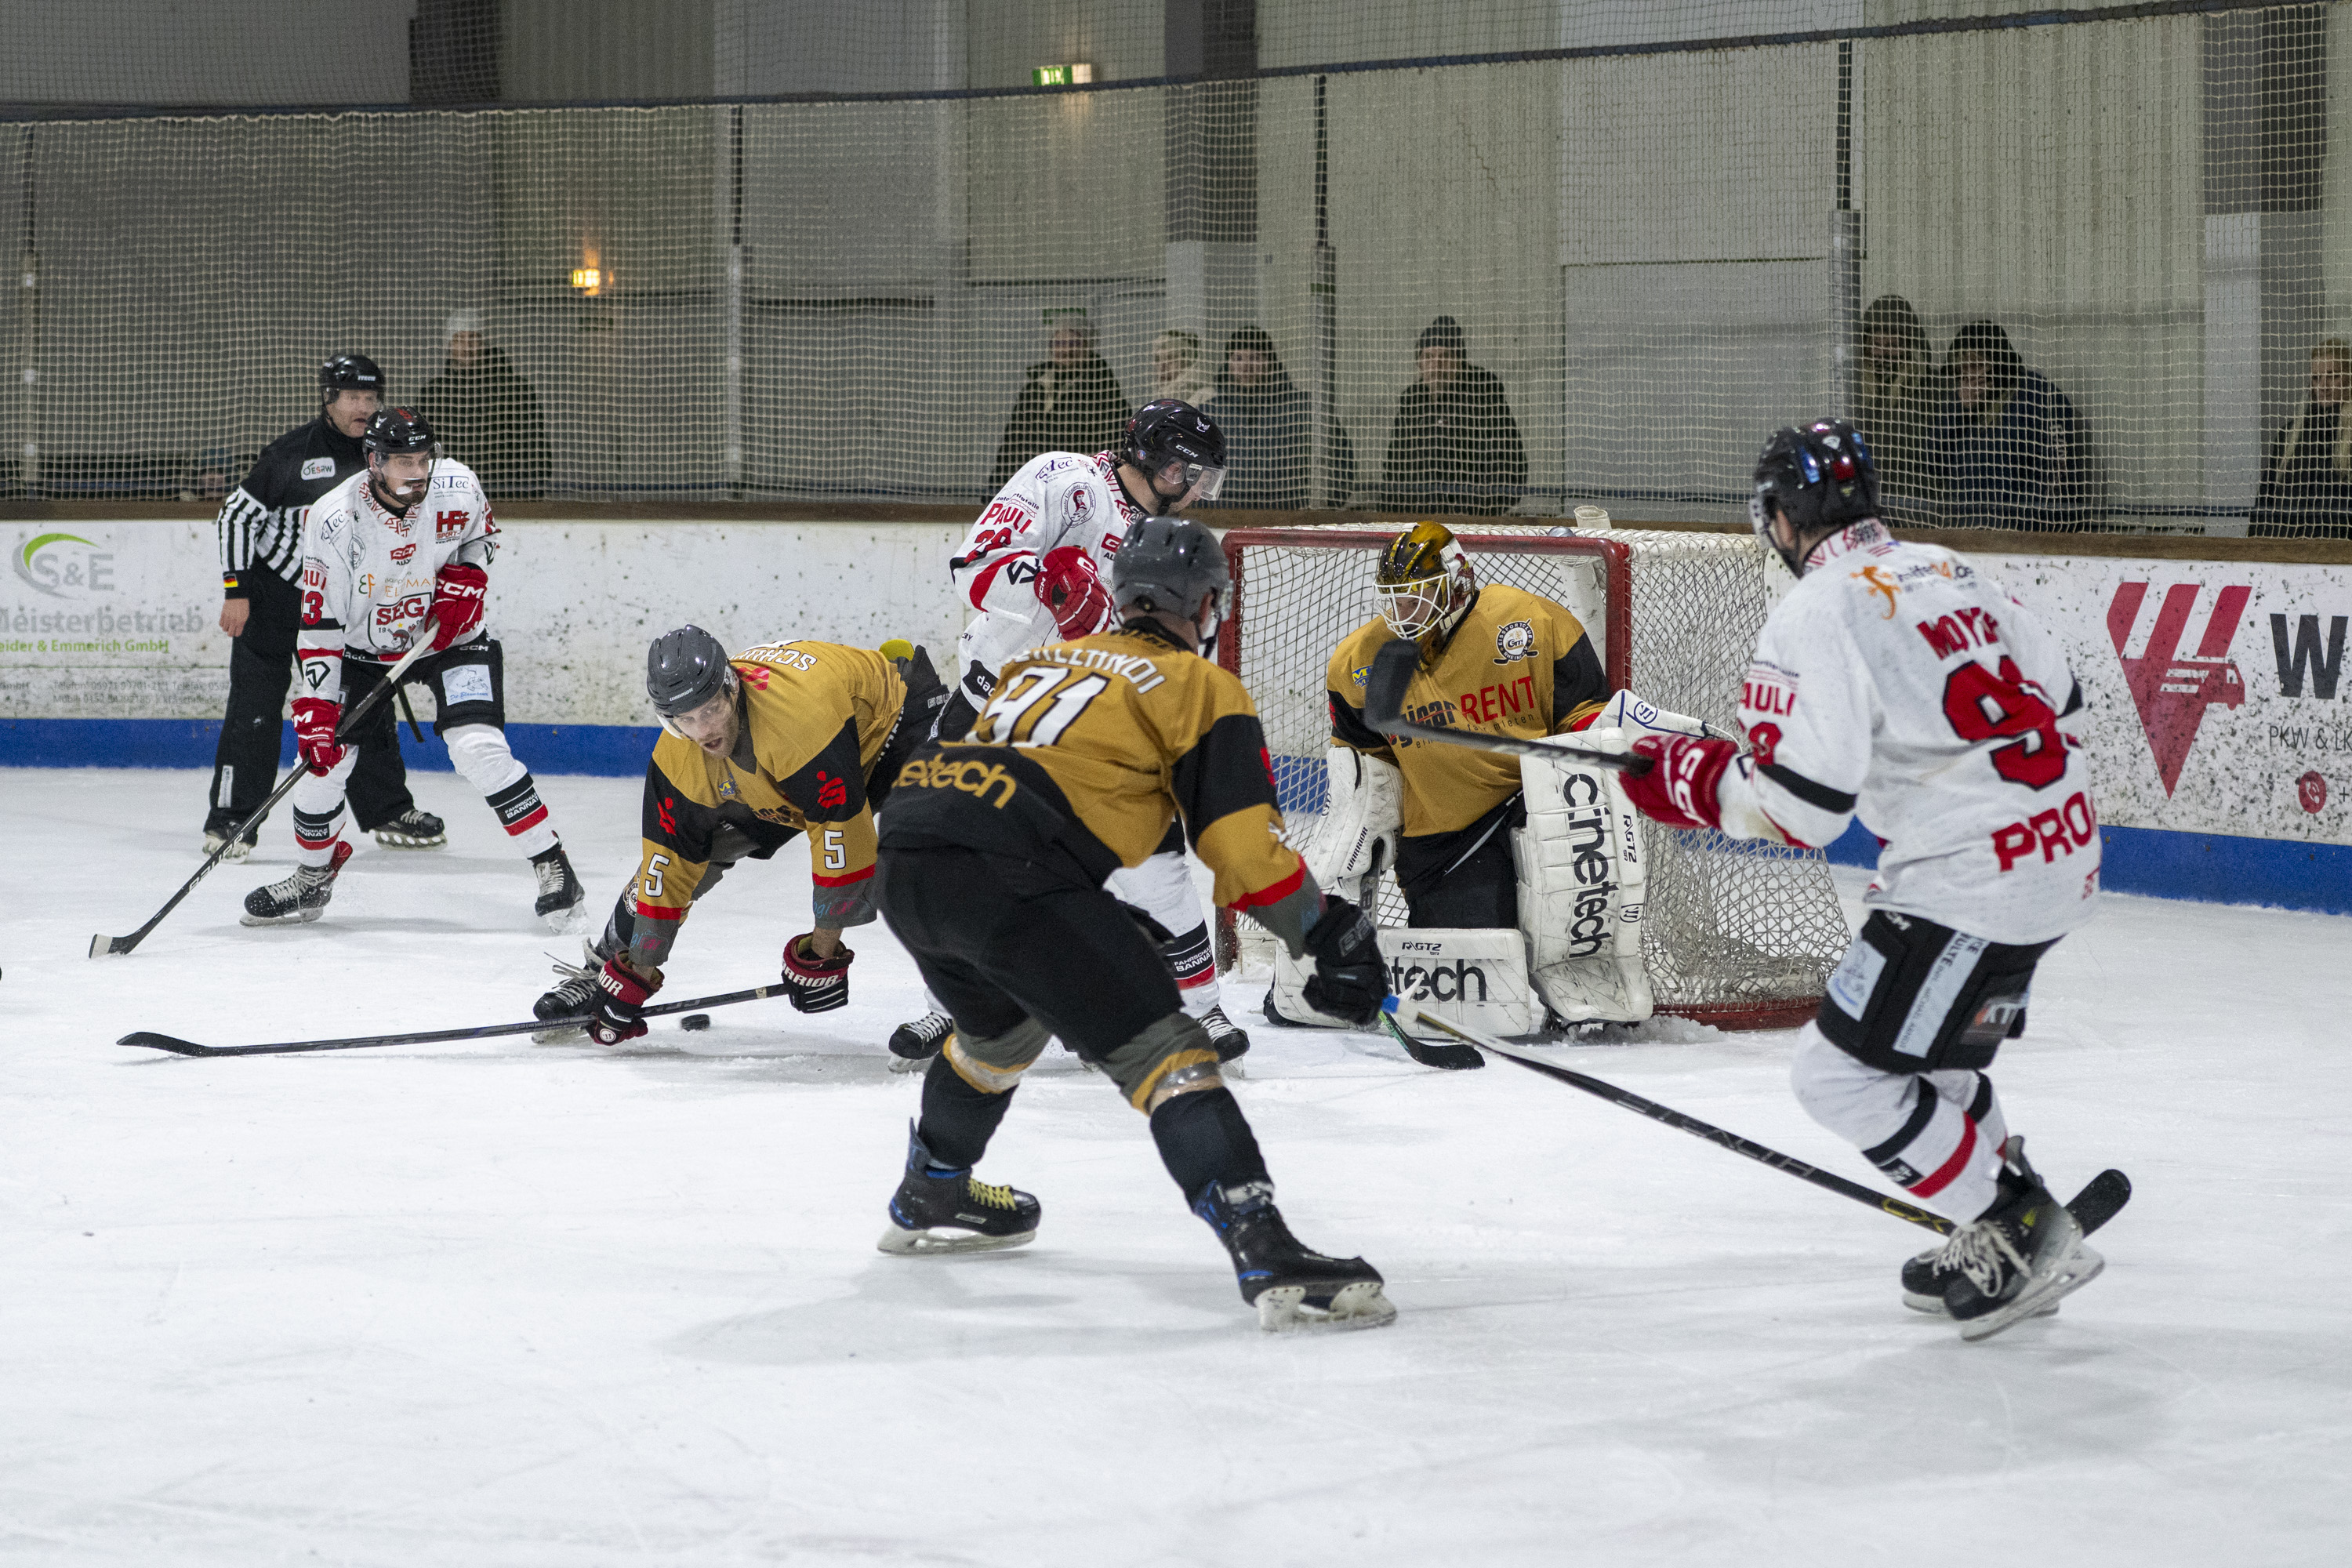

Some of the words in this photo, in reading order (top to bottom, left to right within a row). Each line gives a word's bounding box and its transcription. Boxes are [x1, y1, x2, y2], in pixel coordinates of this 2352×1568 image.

[1176, 445, 1198, 458] CCM
[433, 476, 470, 489] SiTec
[980, 503, 1033, 534] PAULI
[302, 590, 324, 626] 3
[376, 598, 426, 626] SEG
[37, 639, 47, 652] &
[51, 639, 121, 652] Emmerich
[125, 639, 169, 654] GmbH
[964, 666, 1111, 747] 91
[1460, 676, 1535, 725] RENT
[2270, 725, 2309, 750] PKW
[2315, 728, 2328, 750] &
[506, 797, 539, 818] BANNAT
[1991, 791, 2092, 872] PRO
[824, 829, 847, 870] 5
[1346, 827, 1368, 871] WARRIOR
[644, 853, 670, 897] 5
[1563, 773, 1619, 959] cinetech
[782, 963, 840, 988] RRIOR
[1176, 949, 1212, 972] BANNAT
